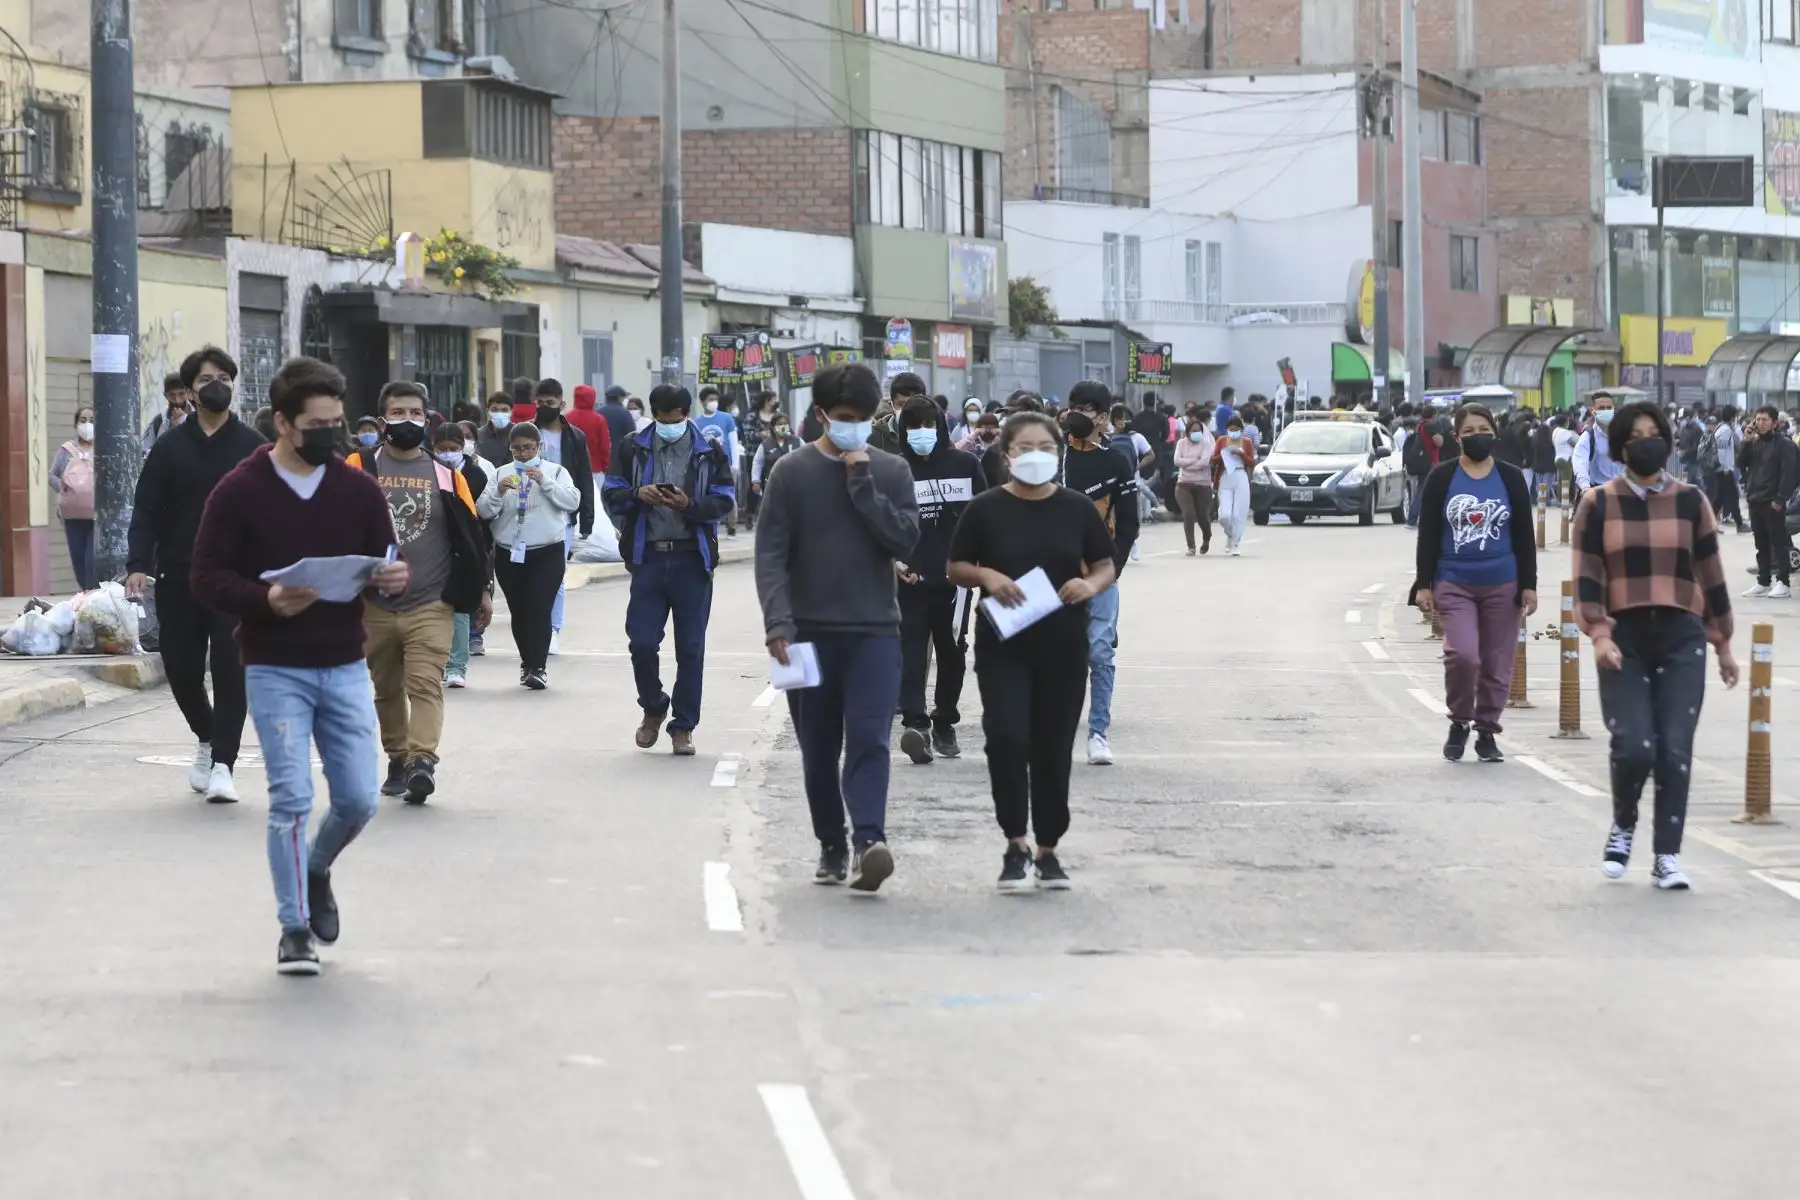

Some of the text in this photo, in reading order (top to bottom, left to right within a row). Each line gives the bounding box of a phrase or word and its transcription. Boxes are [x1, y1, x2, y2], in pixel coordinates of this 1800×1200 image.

[938, 331, 965, 358] MOTUL
[377, 476, 432, 489] EALTREE
[917, 488, 939, 498] istian
